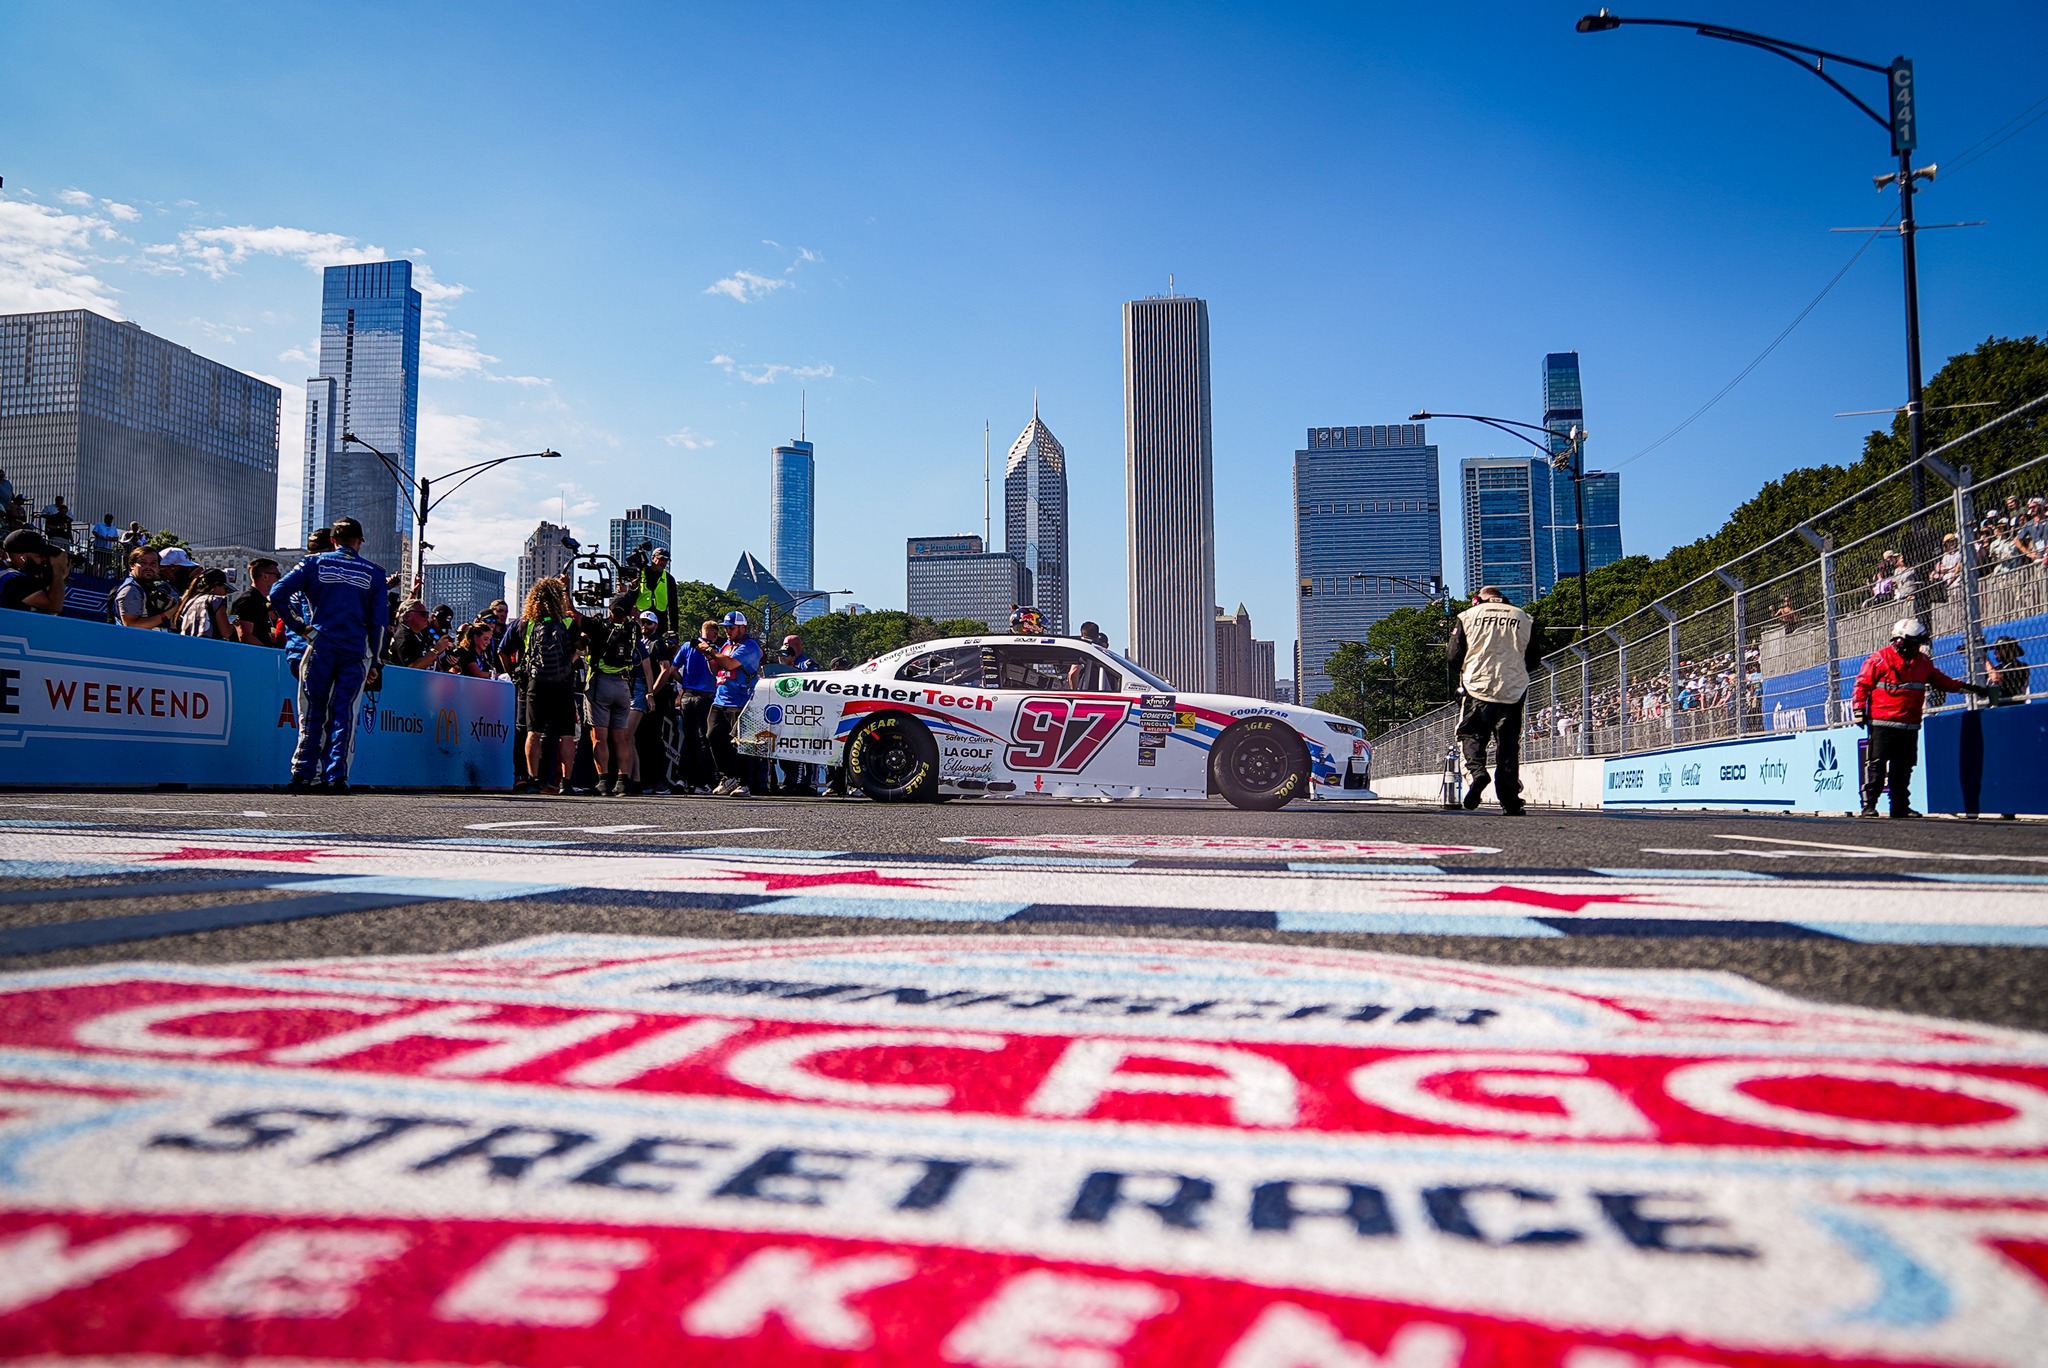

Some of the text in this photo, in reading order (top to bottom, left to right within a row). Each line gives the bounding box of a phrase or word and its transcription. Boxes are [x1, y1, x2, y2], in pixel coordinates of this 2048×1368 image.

[1894, 69, 1913, 142] C441
[1475, 616, 1521, 629] OFFICIAL
[45, 678, 209, 720] WEEKEND
[784, 704, 824, 716] QUAD
[1145, 697, 1170, 707] xfinity
[380, 710, 424, 734] Illinois
[784, 715, 823, 727] LOCK
[1141, 712, 1172, 720] COMETIC
[1229, 706, 1289, 719] GOODYEAR
[471, 716, 510, 744] xfinity
[1005, 697, 1131, 773] 97
[777, 738, 833, 750] ACTION
[851, 718, 896, 774] GOODYEAR
[944, 747, 993, 759] LA GOLF
[905, 761, 930, 795] EAGLE
[1625, 769, 1644, 789] SERIES
[1720, 764, 1747, 781] GEICO
[1759, 757, 1788, 785] xfinity
[1812, 768, 1845, 797] Sports
[72, 998, 2048, 1148] CHICAGO
[148, 1105, 1760, 1259] STREET RACE
[0, 1223, 1720, 1368] EEKEN
